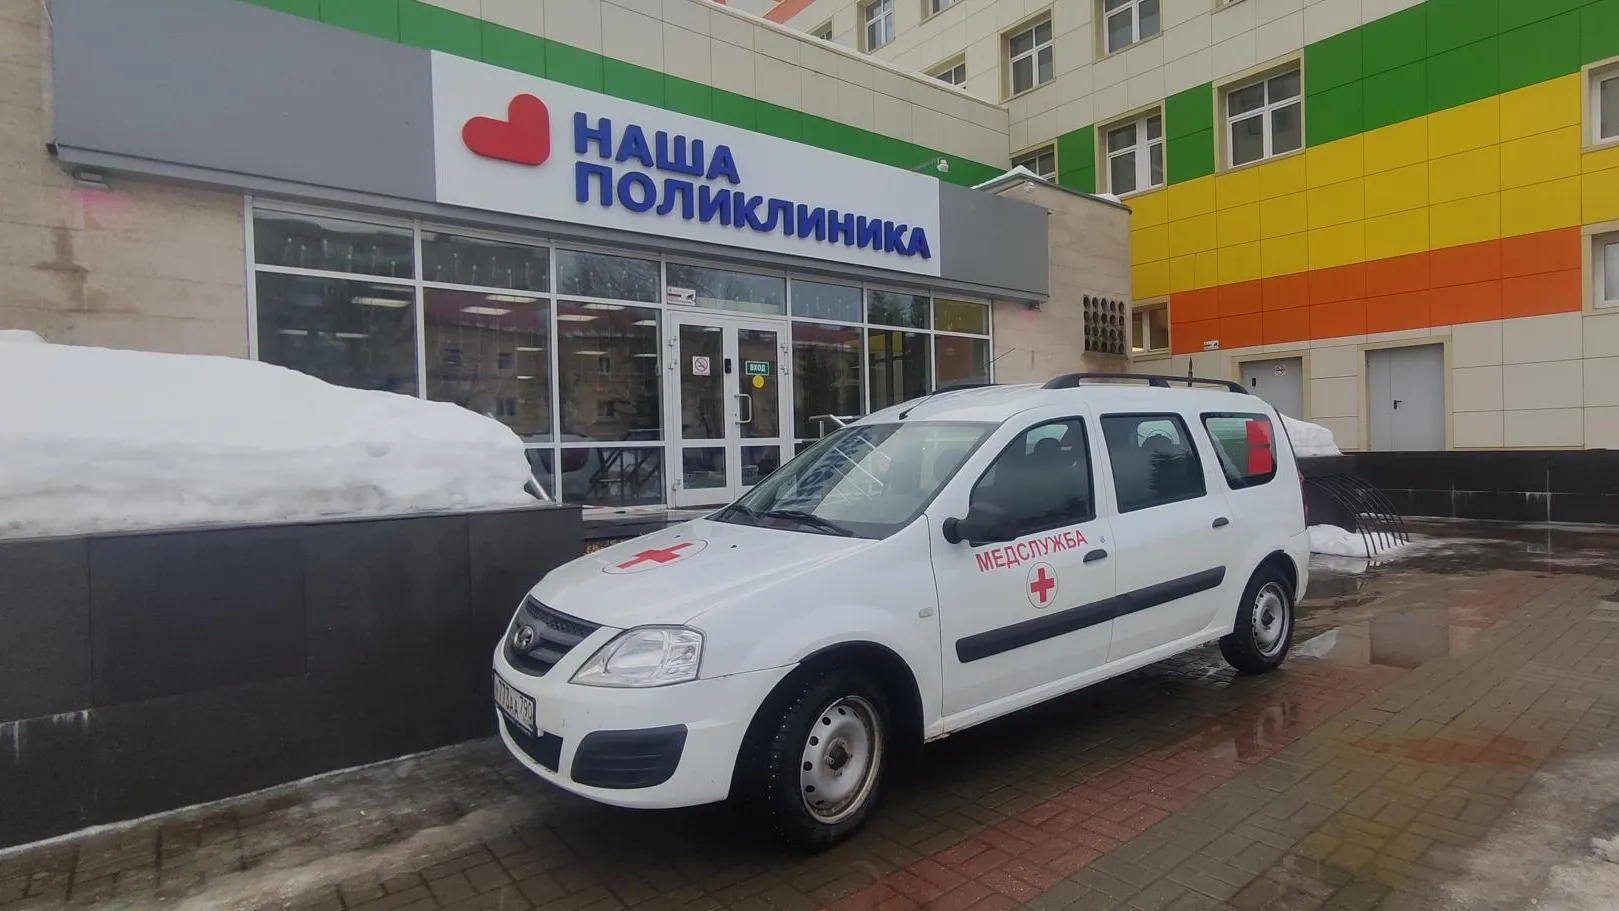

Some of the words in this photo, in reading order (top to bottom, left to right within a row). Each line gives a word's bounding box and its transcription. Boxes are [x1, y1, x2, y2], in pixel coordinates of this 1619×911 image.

[573, 111, 740, 184] НАША
[574, 160, 932, 259] ПОЛИКЛИНИКА
[750, 363, 766, 373] ВХОД
[975, 529, 1088, 572] МЕДСЛУЖБА
